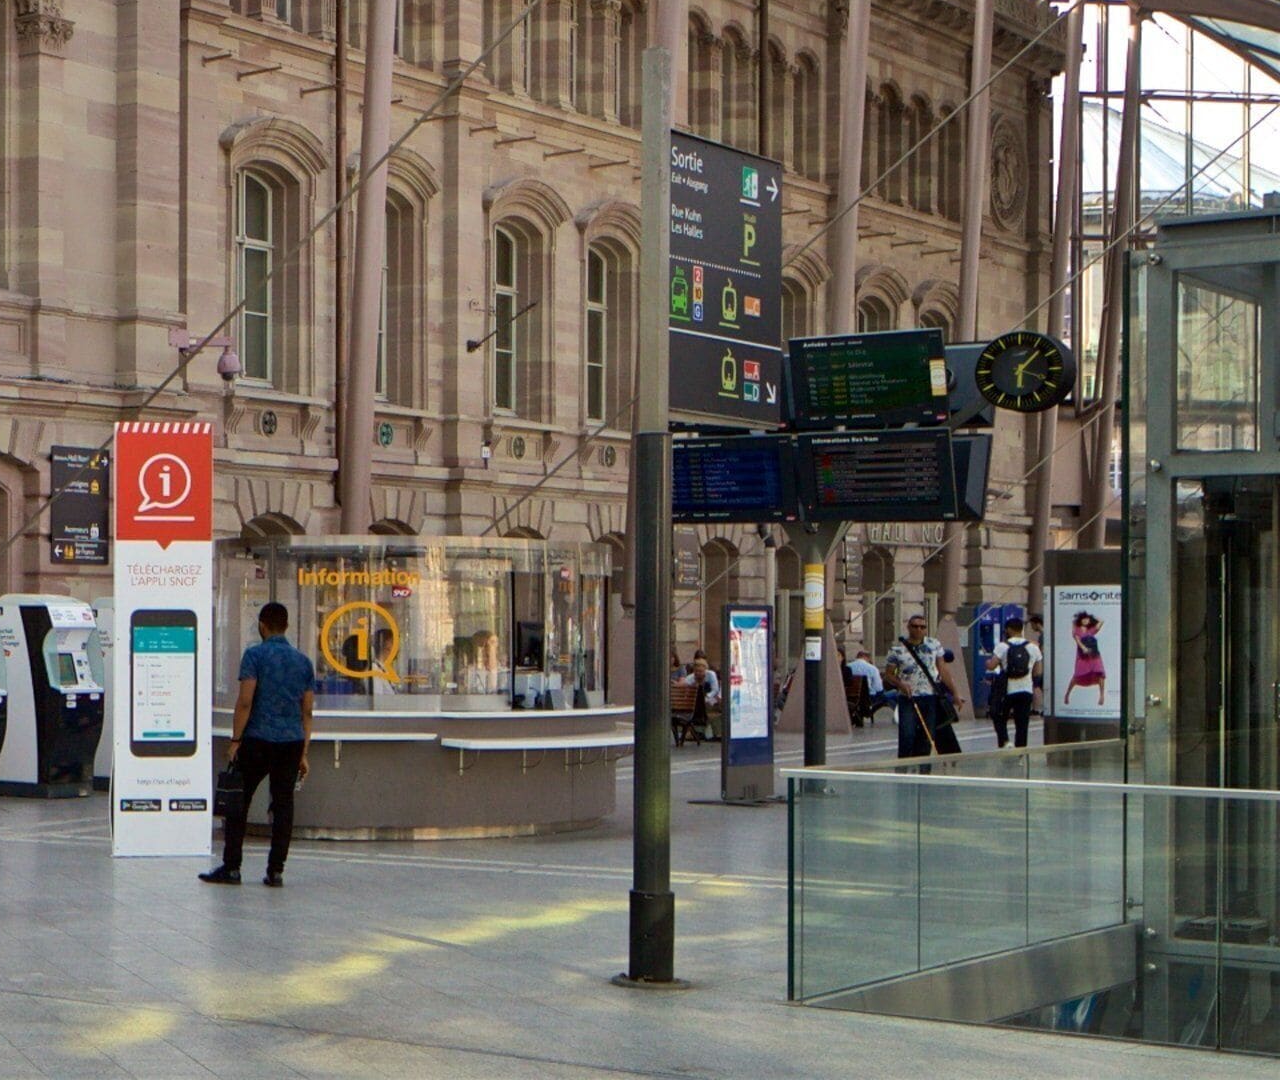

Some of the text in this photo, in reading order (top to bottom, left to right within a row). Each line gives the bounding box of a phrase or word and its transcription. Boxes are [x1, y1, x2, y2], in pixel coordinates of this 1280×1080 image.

[671, 145, 703, 174] Sortie
[671, 220, 703, 240] Les Halles
[752, 383, 760, 399] D
[922, 523, 945, 541] NO
[127, 563, 202, 575] TÉLÉCHARGEZ
[297, 568, 421, 586] Information
[130, 576, 198, 586] L'APPLI SNCF
